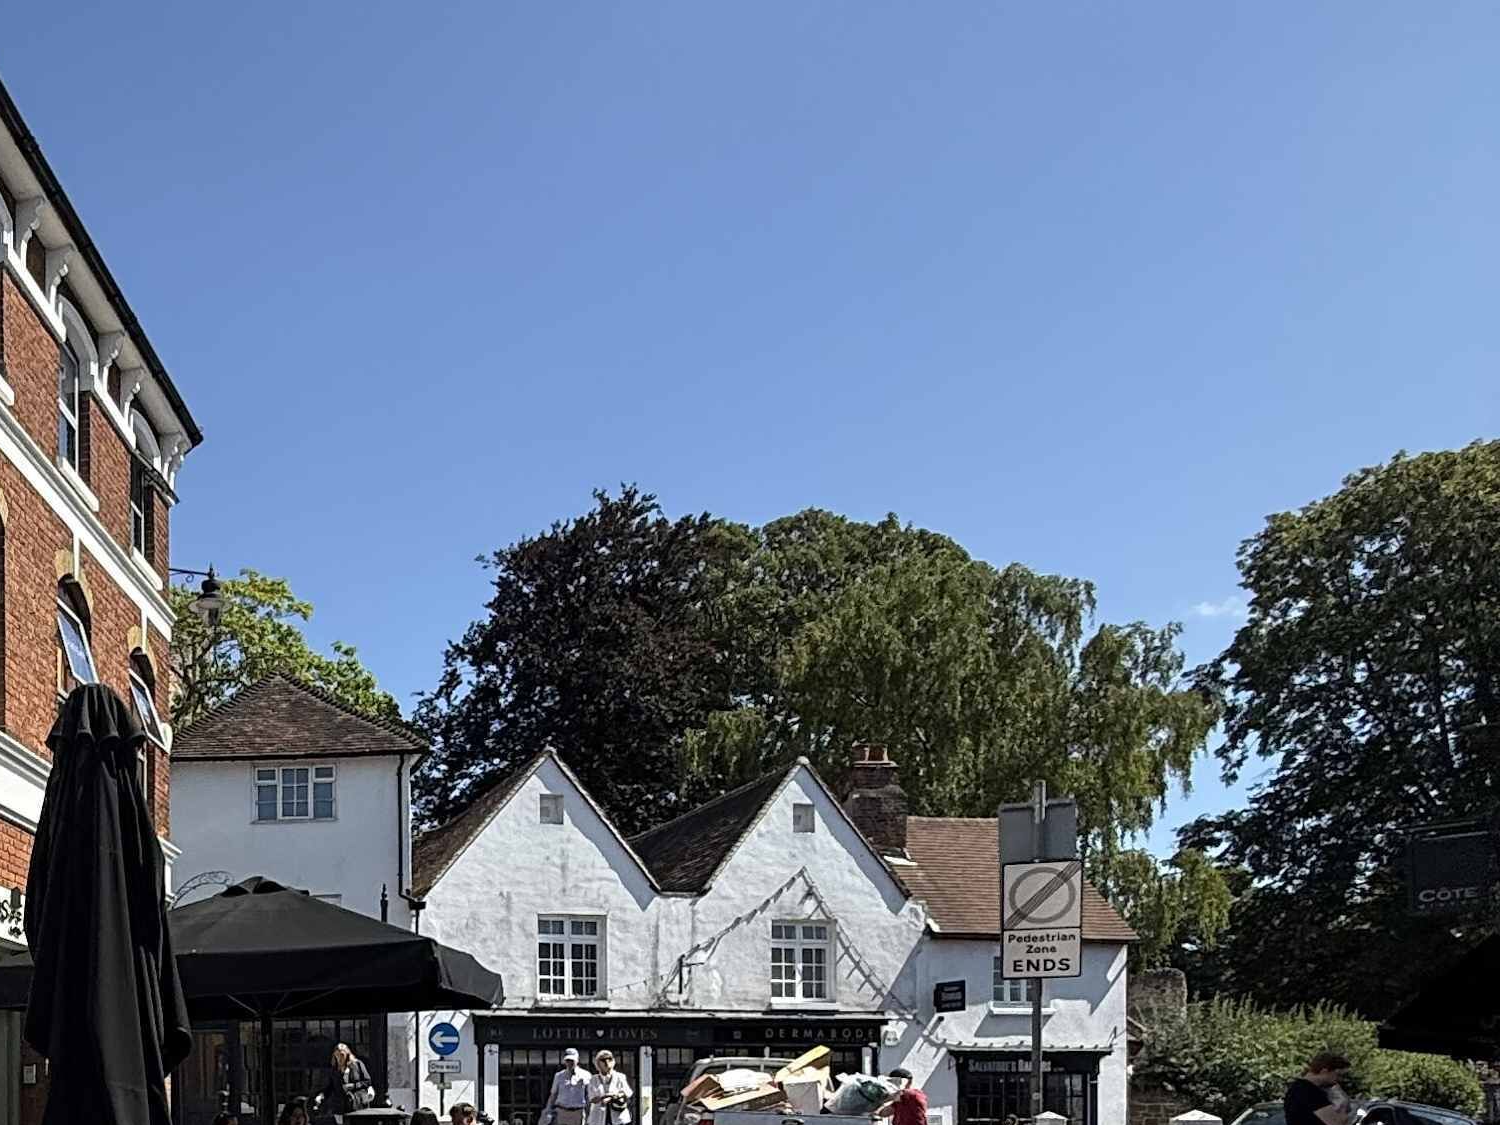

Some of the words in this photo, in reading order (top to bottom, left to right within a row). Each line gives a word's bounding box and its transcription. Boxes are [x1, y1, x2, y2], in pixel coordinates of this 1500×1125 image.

[1007, 931, 1077, 944] Pedestrian
[1025, 943, 1058, 955] Zone
[1012, 957, 1072, 973] ENDS
